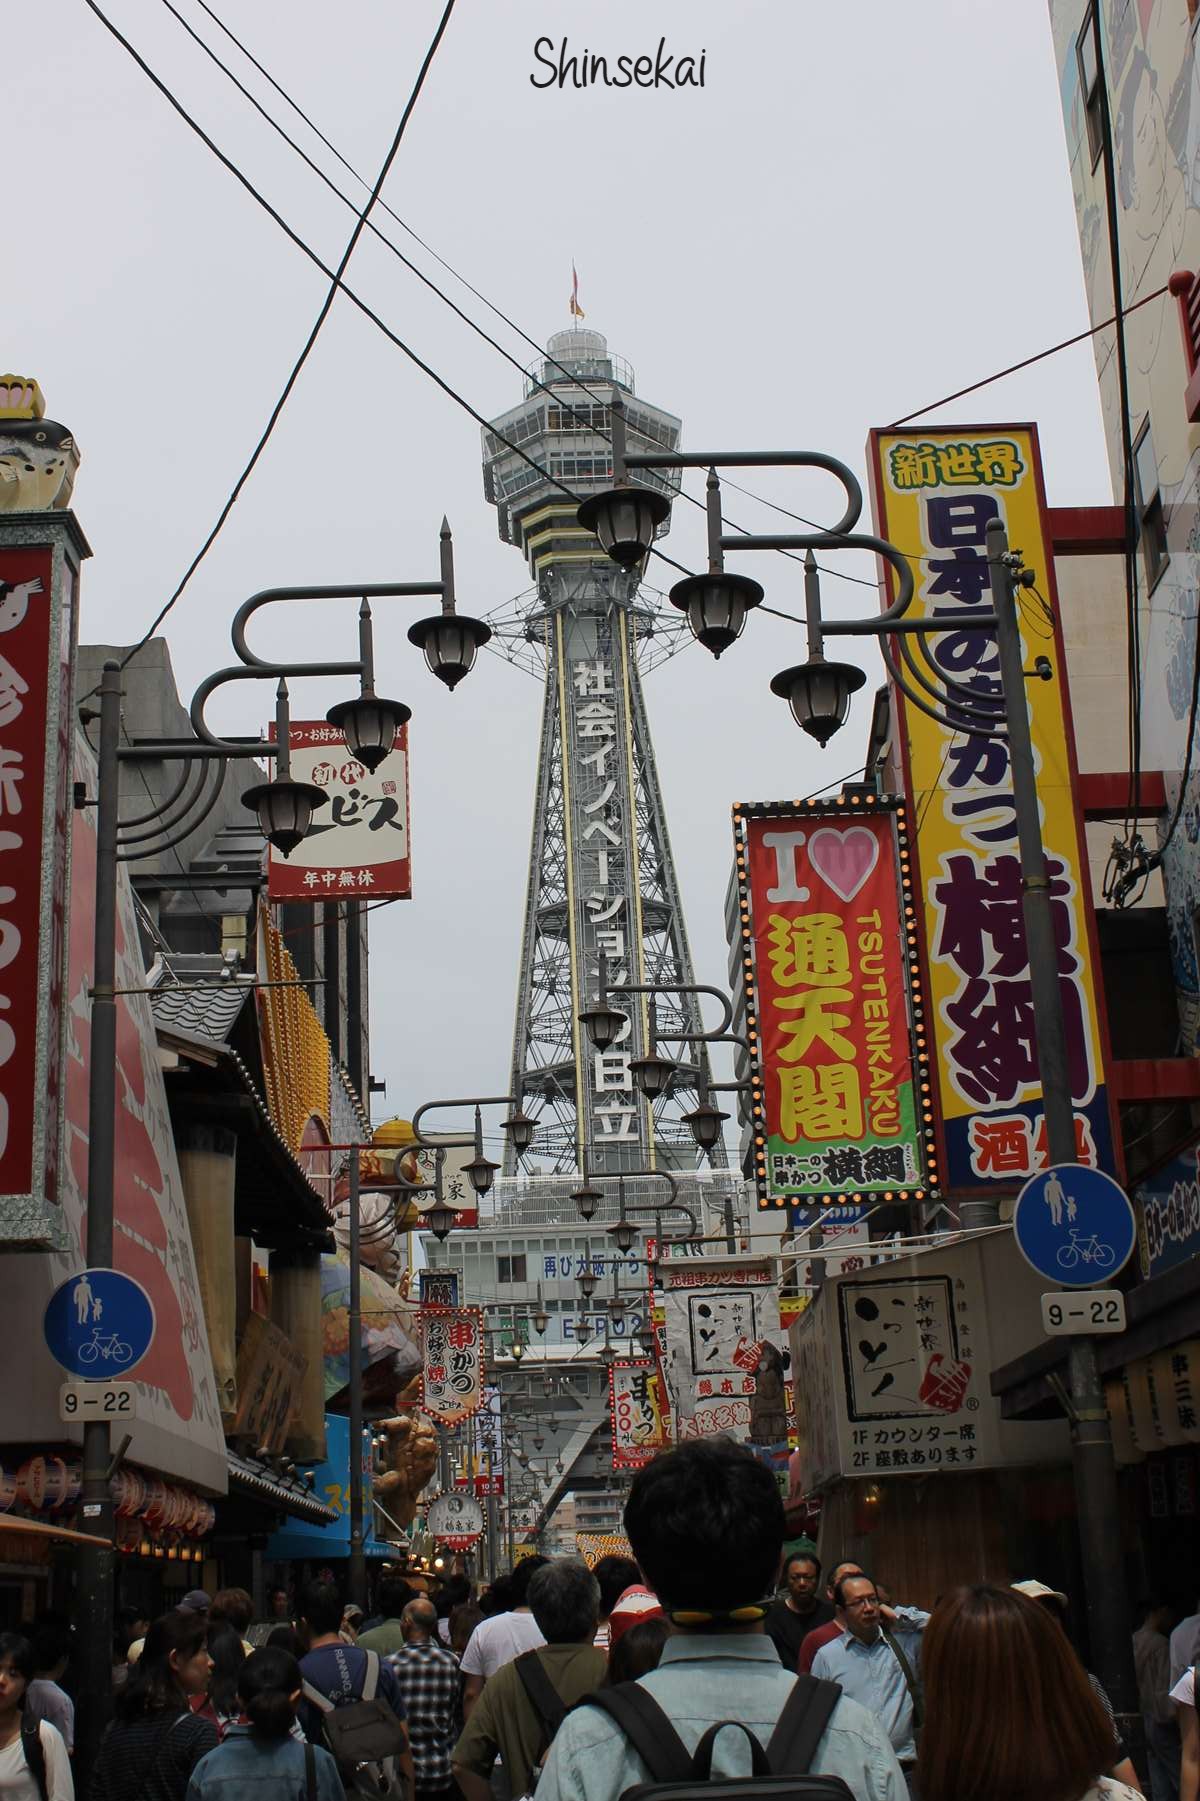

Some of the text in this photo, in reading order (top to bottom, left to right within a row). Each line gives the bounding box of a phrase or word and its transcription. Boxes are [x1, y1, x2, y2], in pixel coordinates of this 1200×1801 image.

[889, 441, 1023, 488] 新世界
[312, 761, 365, 786] 初代
[302, 869, 375, 889] 年中無休
[762, 832, 811, 903] I
[767, 912, 864, 1142] 通天閣
[856, 908, 900, 1136] TSUTENKAKU
[773, 1153, 821, 1168] 日本一の
[775, 1170, 822, 1187] 串かつ
[822, 1145, 905, 1186] 横綱
[914, 1296, 940, 1352] 新世界
[426, 1322, 447, 1395] お好み焼き
[446, 1320, 475, 1395] 串かつ
[679, 1401, 752, 1440] 大阪名物
[852, 1423, 976, 1445] 1F カウンター席
[852, 1446, 978, 1468] 2F 座敷あります
